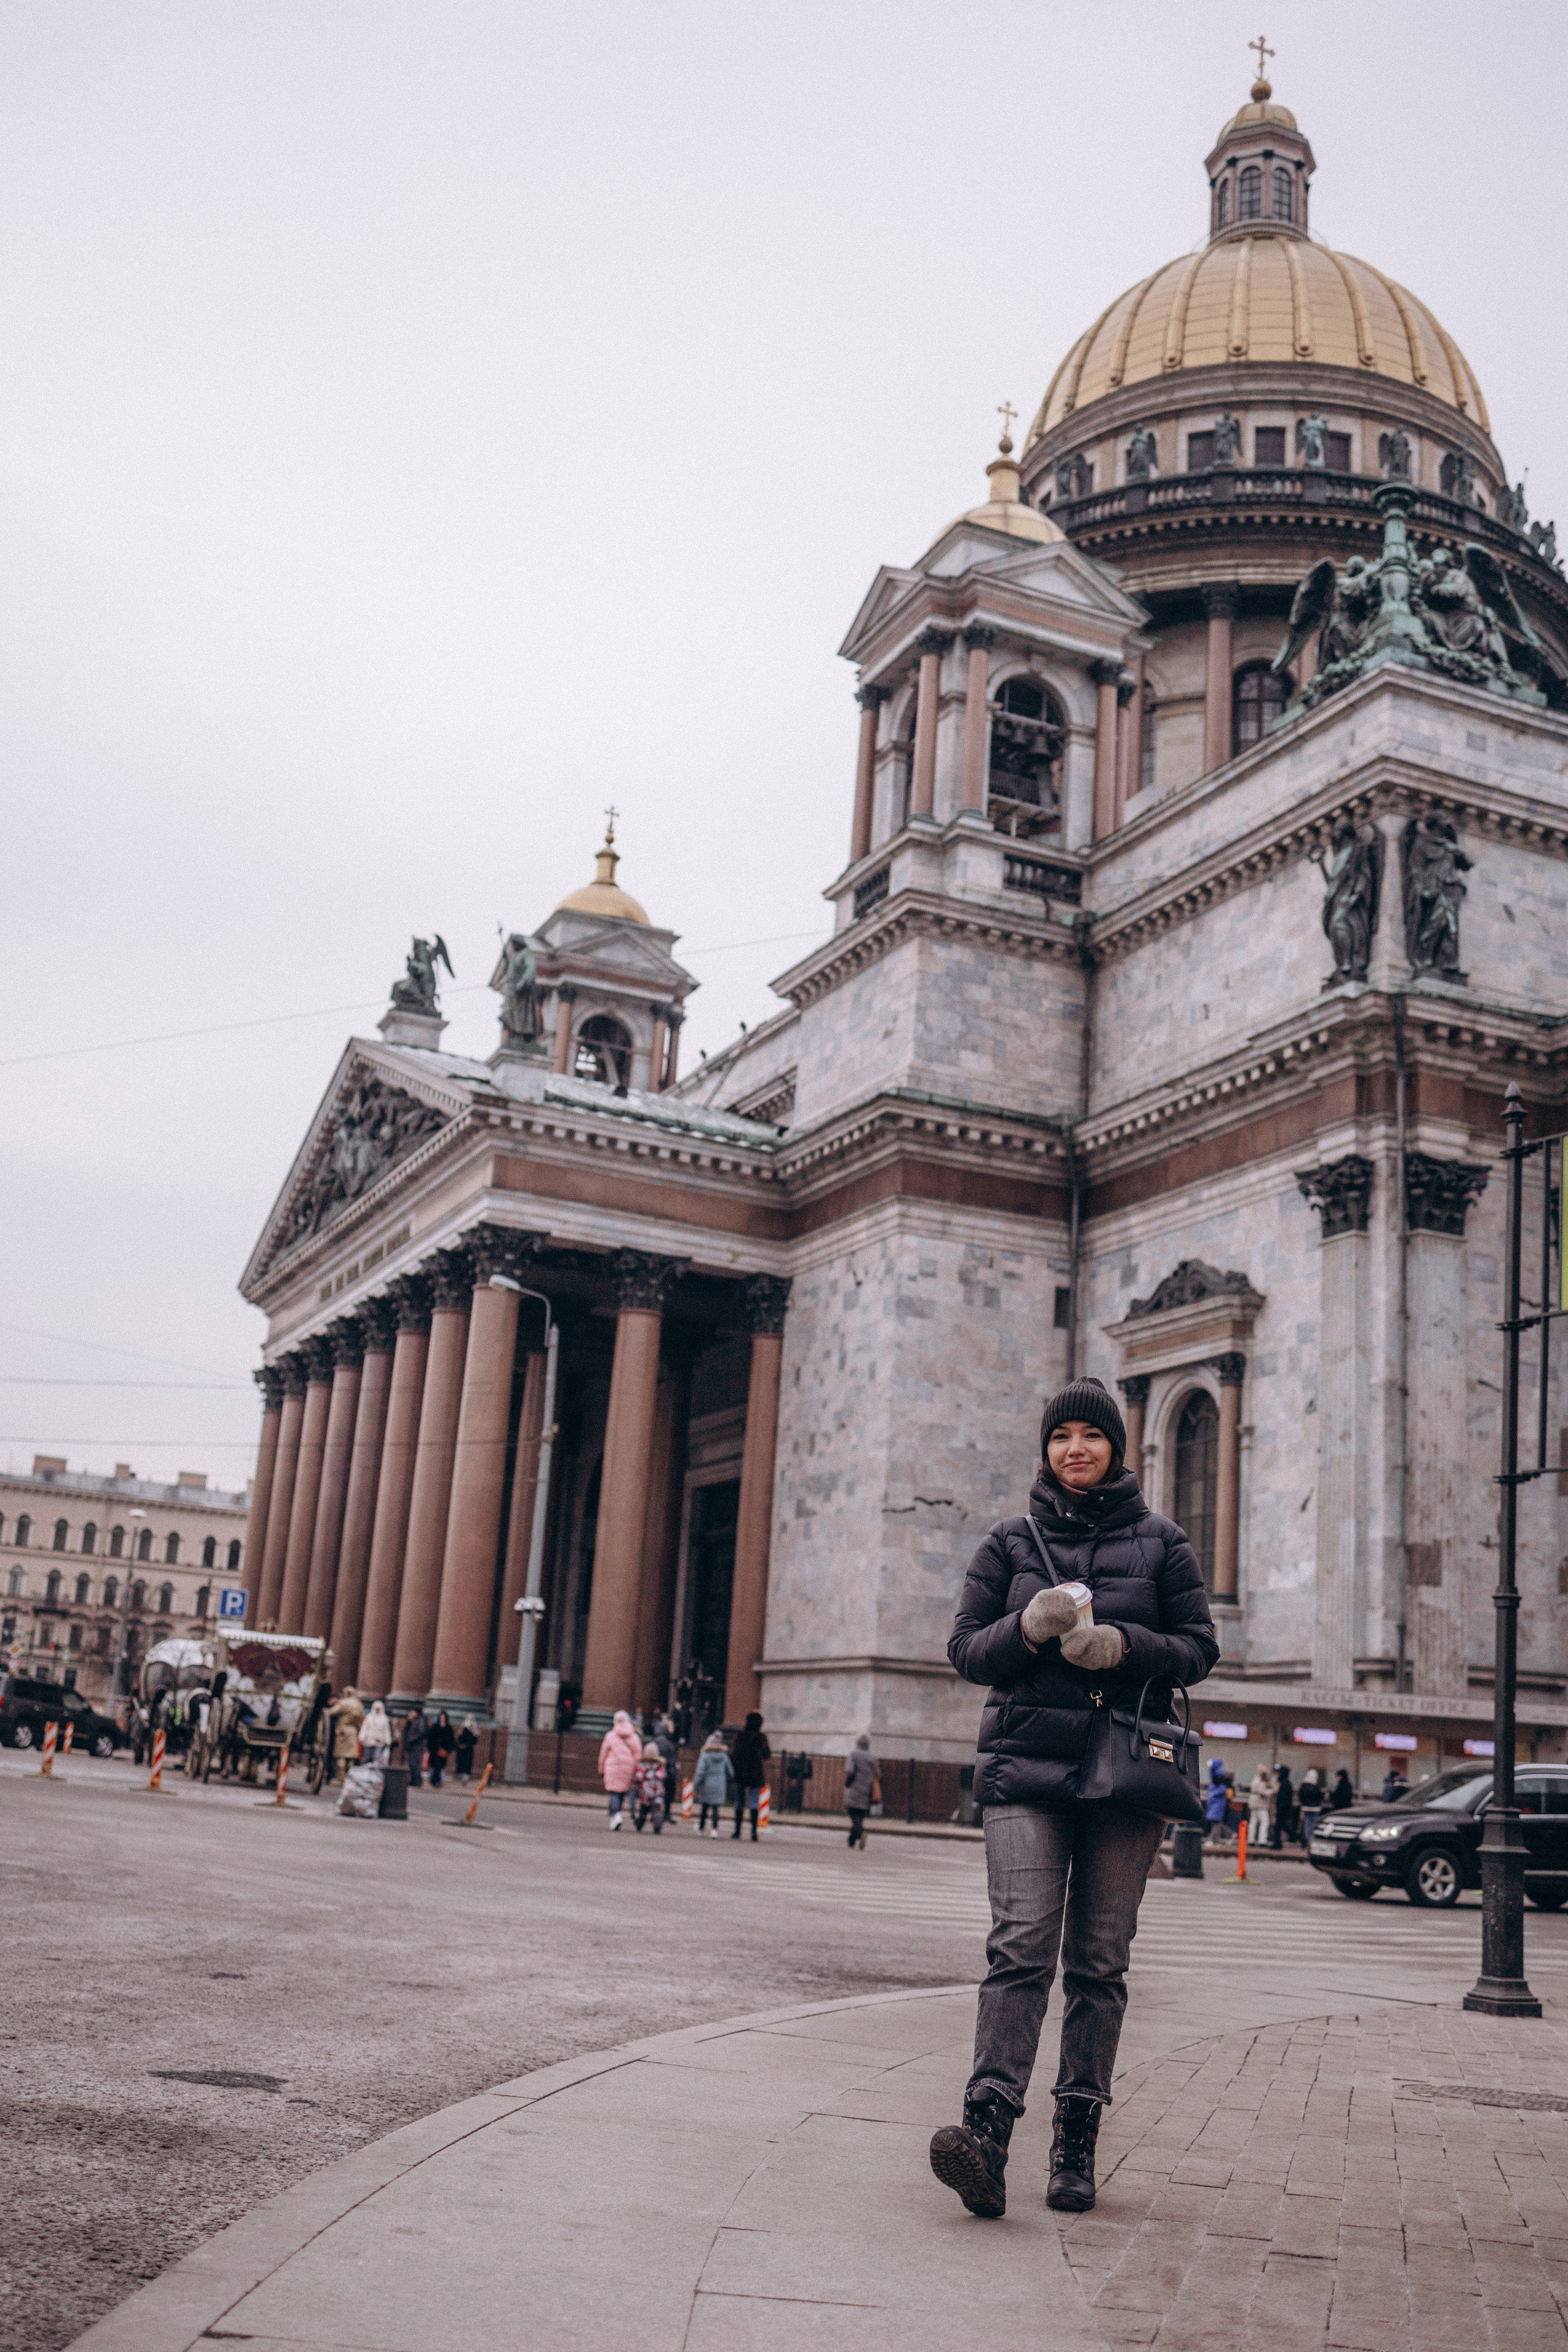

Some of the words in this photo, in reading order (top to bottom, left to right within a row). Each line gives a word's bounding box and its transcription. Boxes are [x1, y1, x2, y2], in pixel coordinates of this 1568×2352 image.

[225, 1592, 244, 1615] P
[1364, 1695, 1414, 1711] TICKET
[1420, 1699, 1470, 1714] OFFICE
